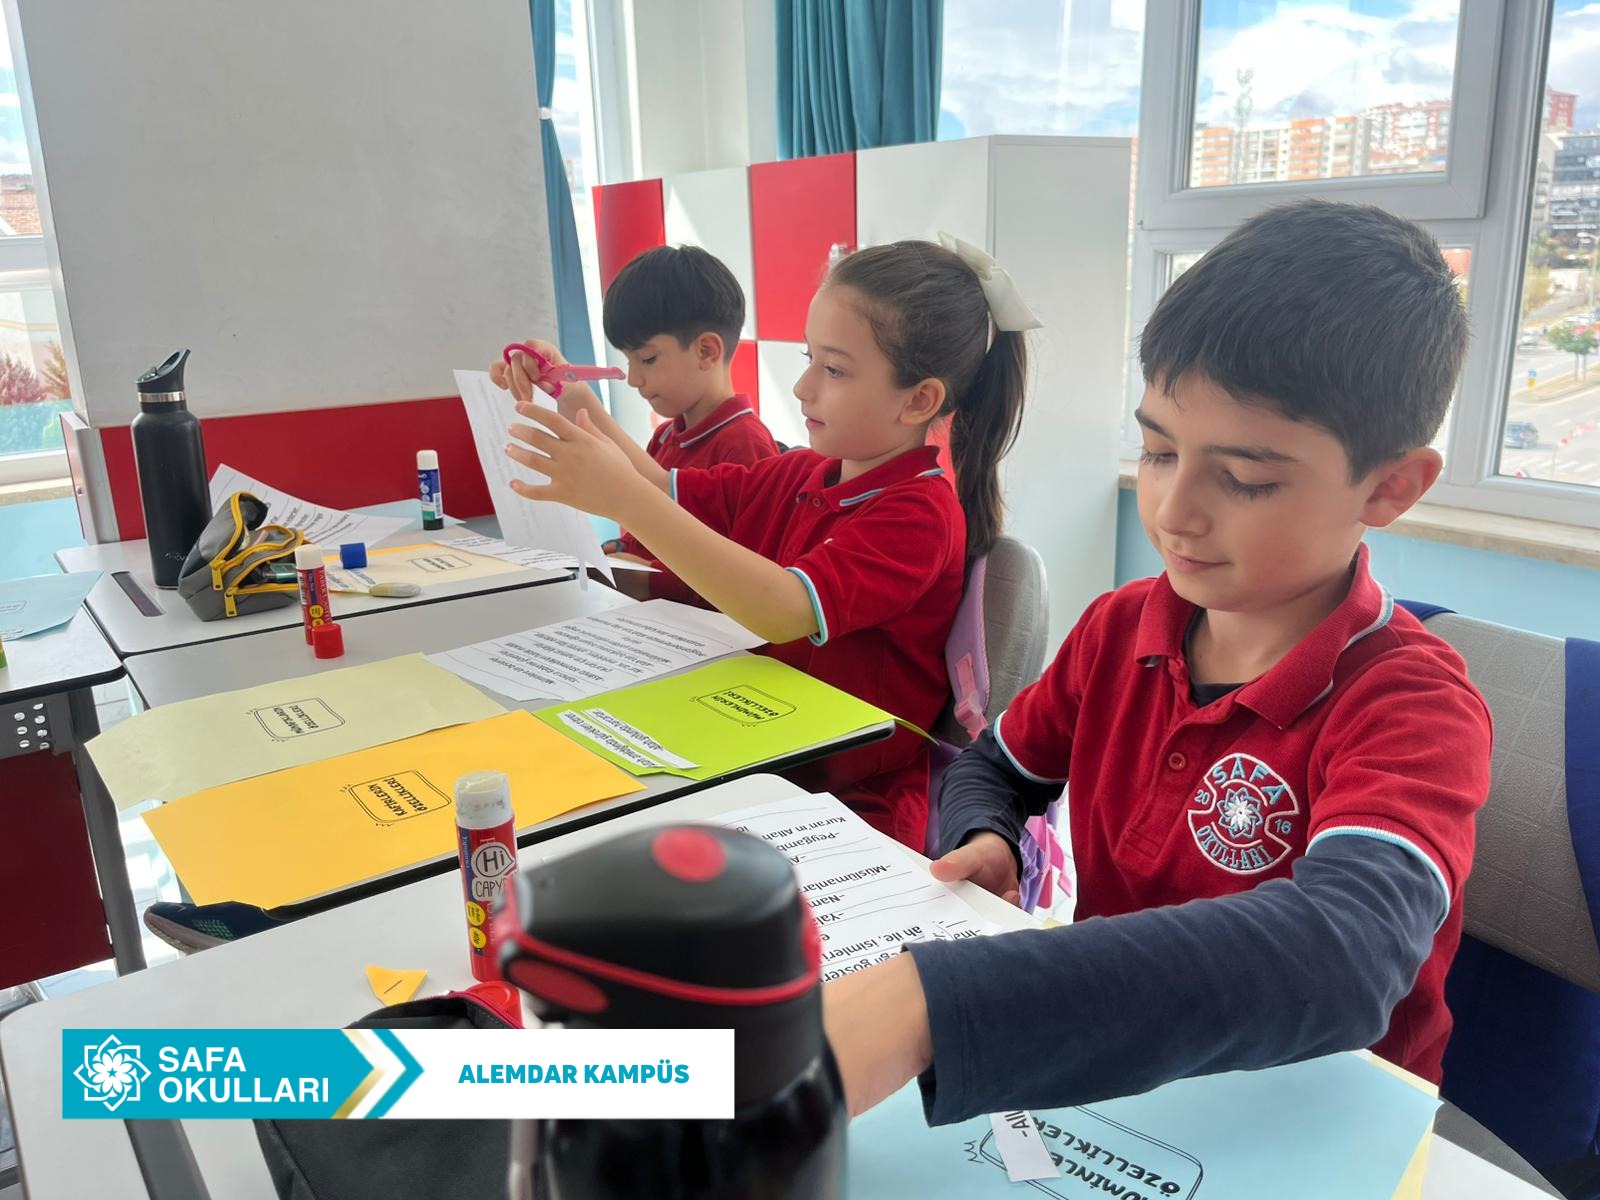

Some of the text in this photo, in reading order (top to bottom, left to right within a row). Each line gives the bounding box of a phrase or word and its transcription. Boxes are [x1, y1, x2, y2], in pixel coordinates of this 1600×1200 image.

[1212, 756, 1284, 805] SAFA
[1194, 789, 1210, 805] 20
[761, 827, 792, 841] Allah
[1197, 826, 1273, 869] OKULLARI
[482, 851, 505, 872] Hi
